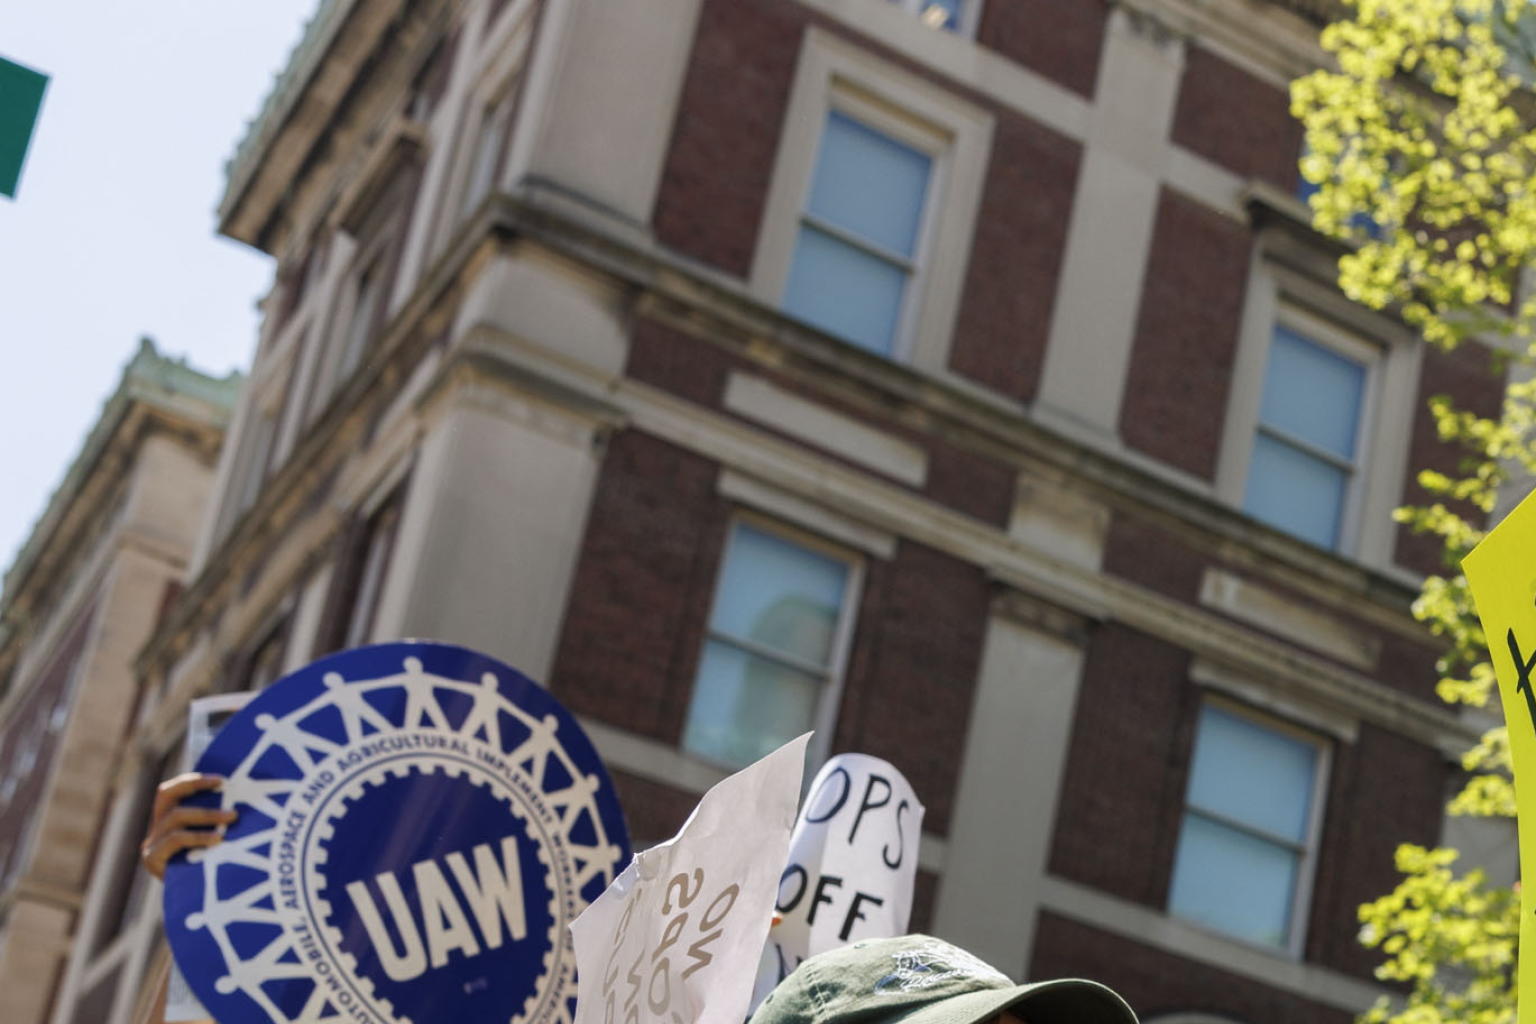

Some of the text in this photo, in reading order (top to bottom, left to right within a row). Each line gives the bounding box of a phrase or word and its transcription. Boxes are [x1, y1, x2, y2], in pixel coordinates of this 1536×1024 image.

[277, 810, 307, 910] AEROSPACE
[302, 770, 335, 806] AND
[336, 733, 469, 772] AGRICULTURAL
[806, 766, 908, 870] OPS
[345, 835, 527, 983] UAW
[775, 864, 884, 942] OFF
